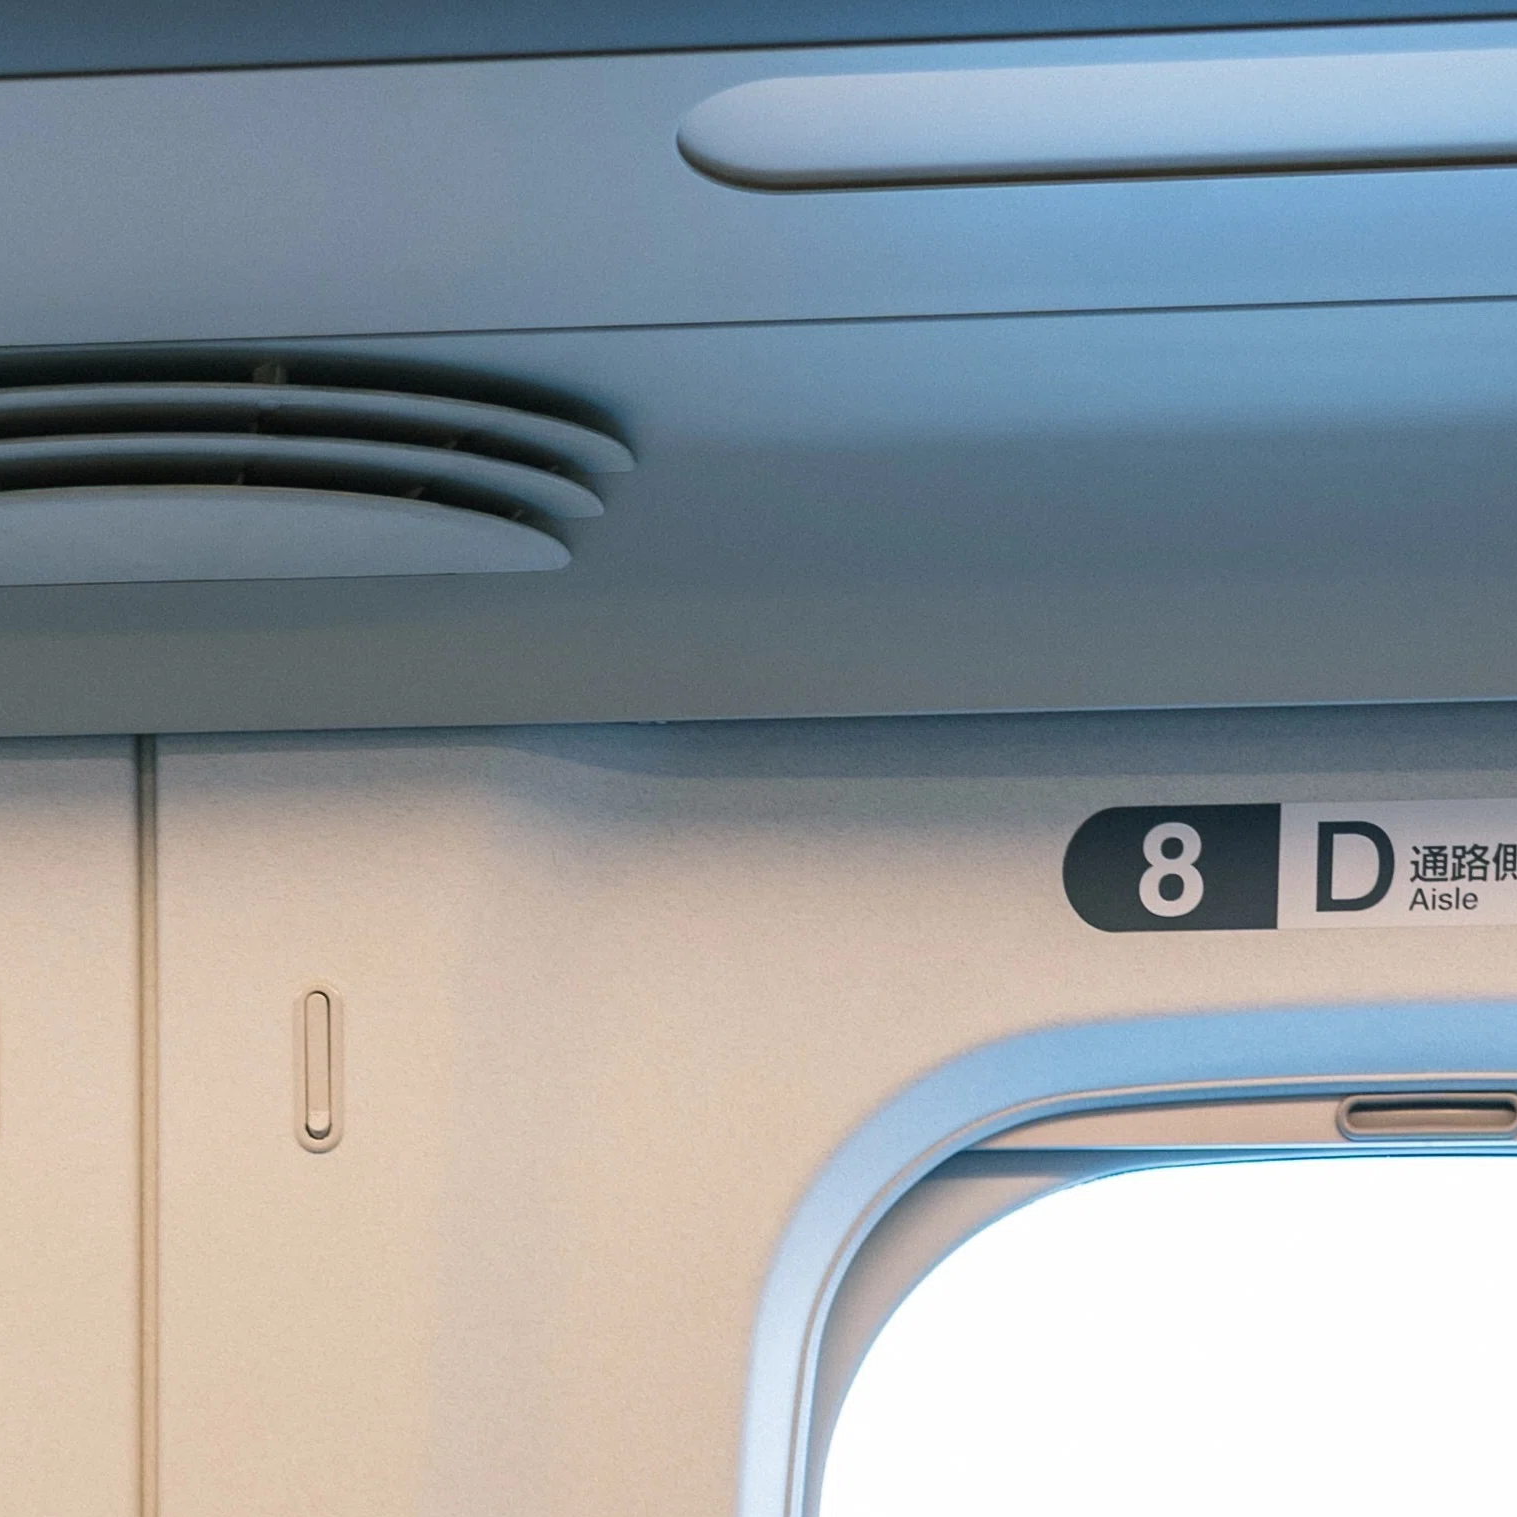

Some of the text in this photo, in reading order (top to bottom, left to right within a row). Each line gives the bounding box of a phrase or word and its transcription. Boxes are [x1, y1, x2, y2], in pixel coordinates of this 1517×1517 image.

[1138, 822, 1204, 918] 8
[1315, 820, 1396, 913] D
[1409, 886, 1479, 911] Aisle
